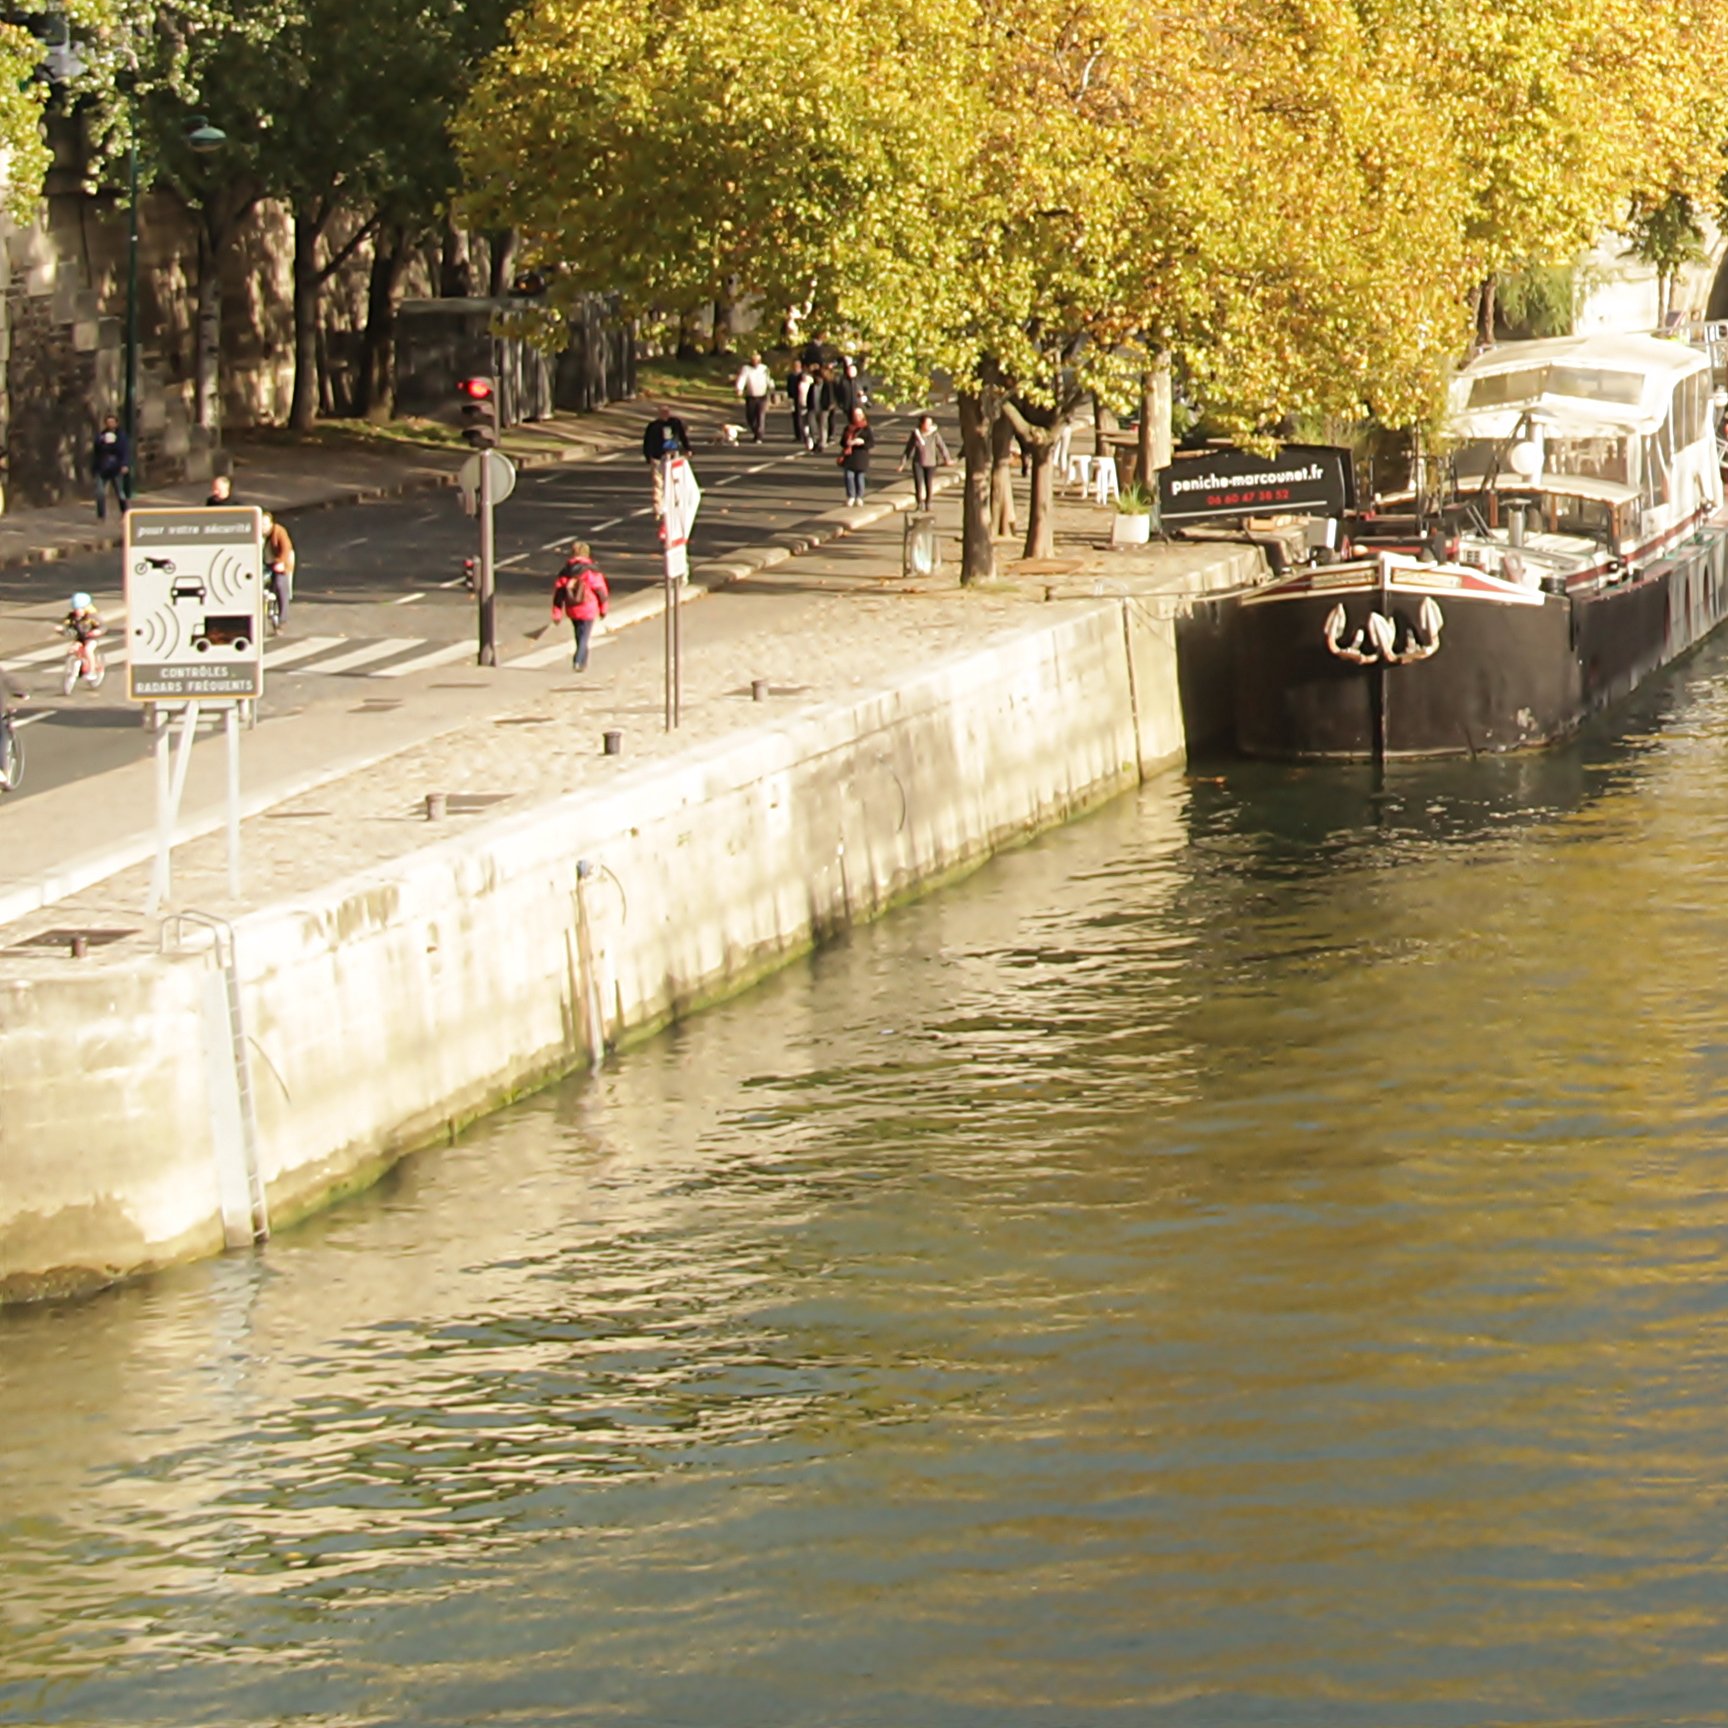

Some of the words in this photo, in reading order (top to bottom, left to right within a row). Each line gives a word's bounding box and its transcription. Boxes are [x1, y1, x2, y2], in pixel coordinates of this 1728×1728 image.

[1171, 464, 1324, 495] peniche-marcounet.fr
[1207, 495, 1221, 505] 06
[1225, 493, 1239, 503] 60
[1242, 491, 1255, 502] 47
[1275, 489, 1290, 499] 52
[138, 526, 164, 538] pour
[168, 525, 200, 534] votre
[204, 523, 251, 534] sécurité
[161, 666, 228, 678] CONTRÔLES
[136, 682, 182, 693] RADARS
[188, 680, 253, 692] FRÉQUENTS
